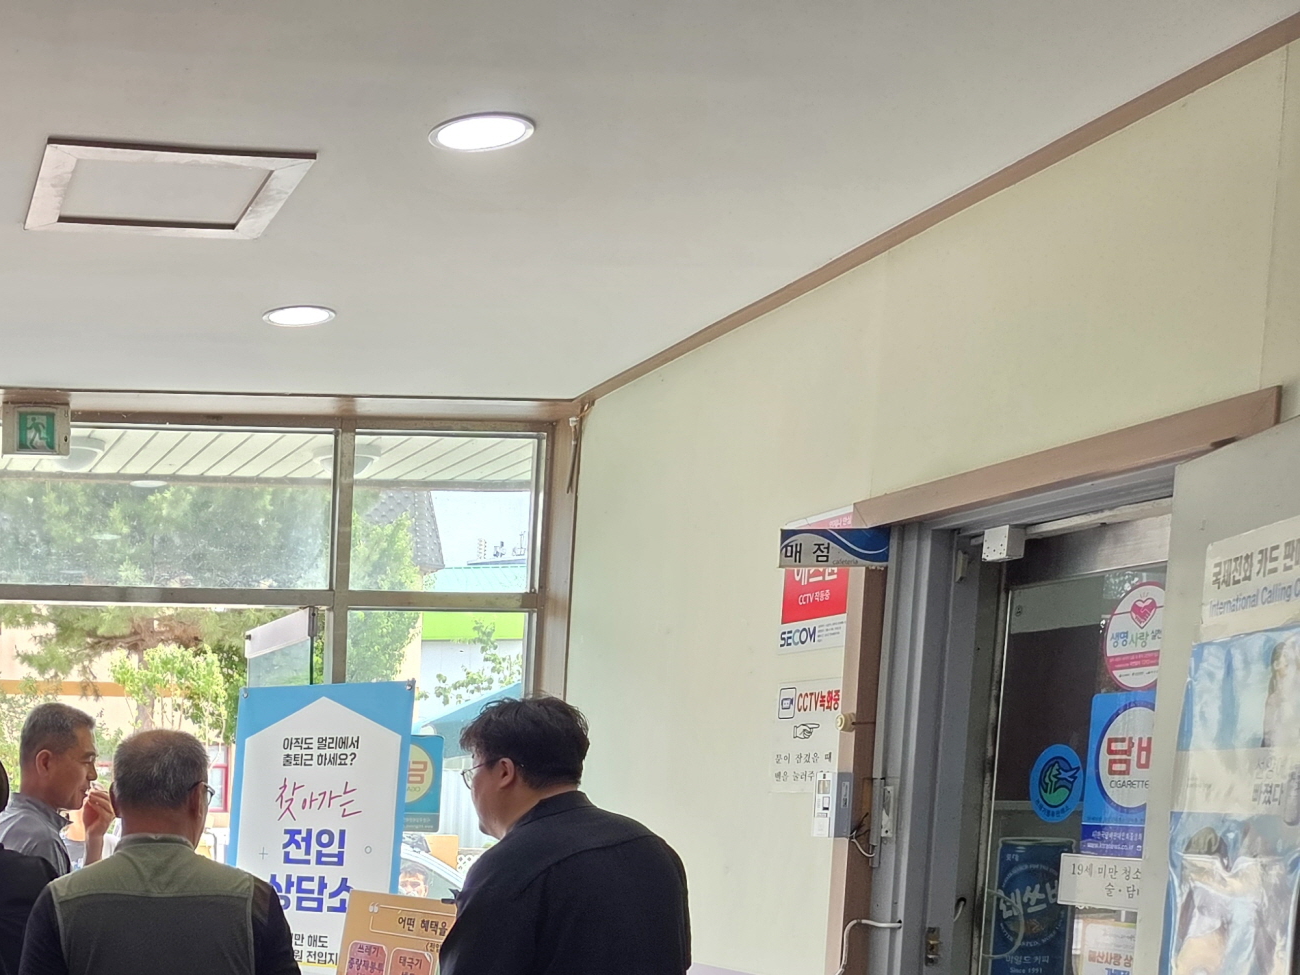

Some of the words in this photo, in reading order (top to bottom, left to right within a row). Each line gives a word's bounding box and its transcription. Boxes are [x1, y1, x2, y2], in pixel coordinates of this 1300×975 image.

[1212, 552, 1253, 590] 국제전화
[1256, 545, 1280, 577] 카드
[1209, 588, 1259, 617] International
[1261, 583, 1293, 605] Calling
[779, 626, 816, 647] SECOM
[282, 736, 314, 751] 아직도
[316, 735, 360, 750] 멀리에서
[282, 752, 314, 767] 출퇴근
[316, 752, 357, 767] 하세요?
[775, 753, 791, 764] 문이
[824, 752, 832, 763] 때
[1110, 780, 1149, 790] CIGARETTE
[275, 777, 362, 821] 찾아가는
[282, 828, 346, 867] 전입
[1071, 863, 1093, 878] 19세
[1097, 865, 1118, 880] 미만
[1122, 866, 1141, 881] 청소
[269, 874, 353, 913] 상담소
[398, 916, 415, 932] 어떤
[291, 933, 304, 947] 만
[307, 935, 328, 949] 해도
[306, 951, 338, 965] 전입지
[357, 944, 380, 957] 쓰레기
[399, 956, 422, 970] 태극기
